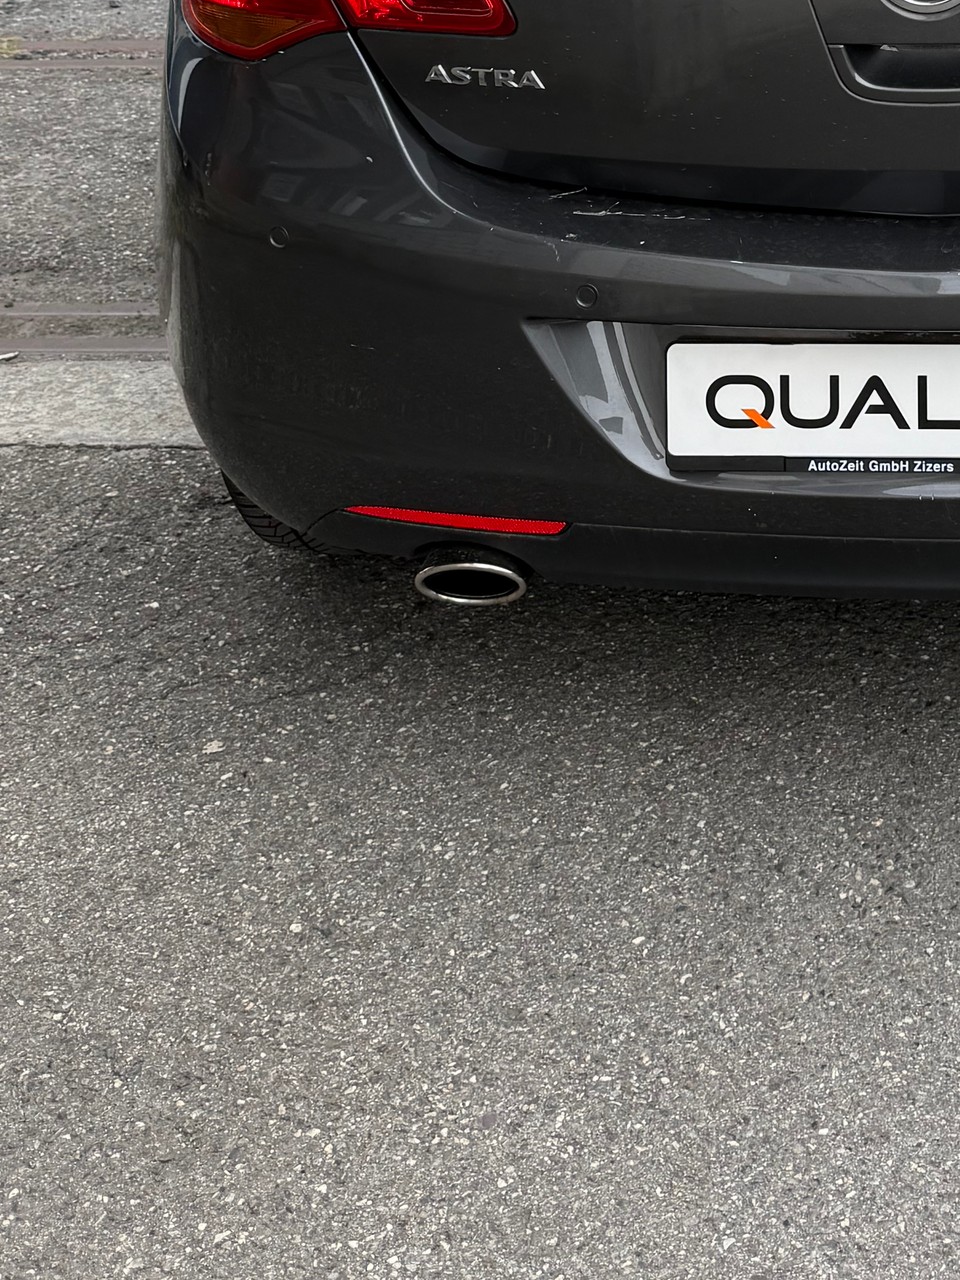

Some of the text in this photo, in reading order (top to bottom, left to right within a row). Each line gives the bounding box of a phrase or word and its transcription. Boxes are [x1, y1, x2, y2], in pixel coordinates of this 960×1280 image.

[425, 64, 546, 90] ASTRA
[808, 459, 865, 472] AutoZeit
[868, 459, 909, 472] GmbH
[913, 459, 954, 472] Zizers
